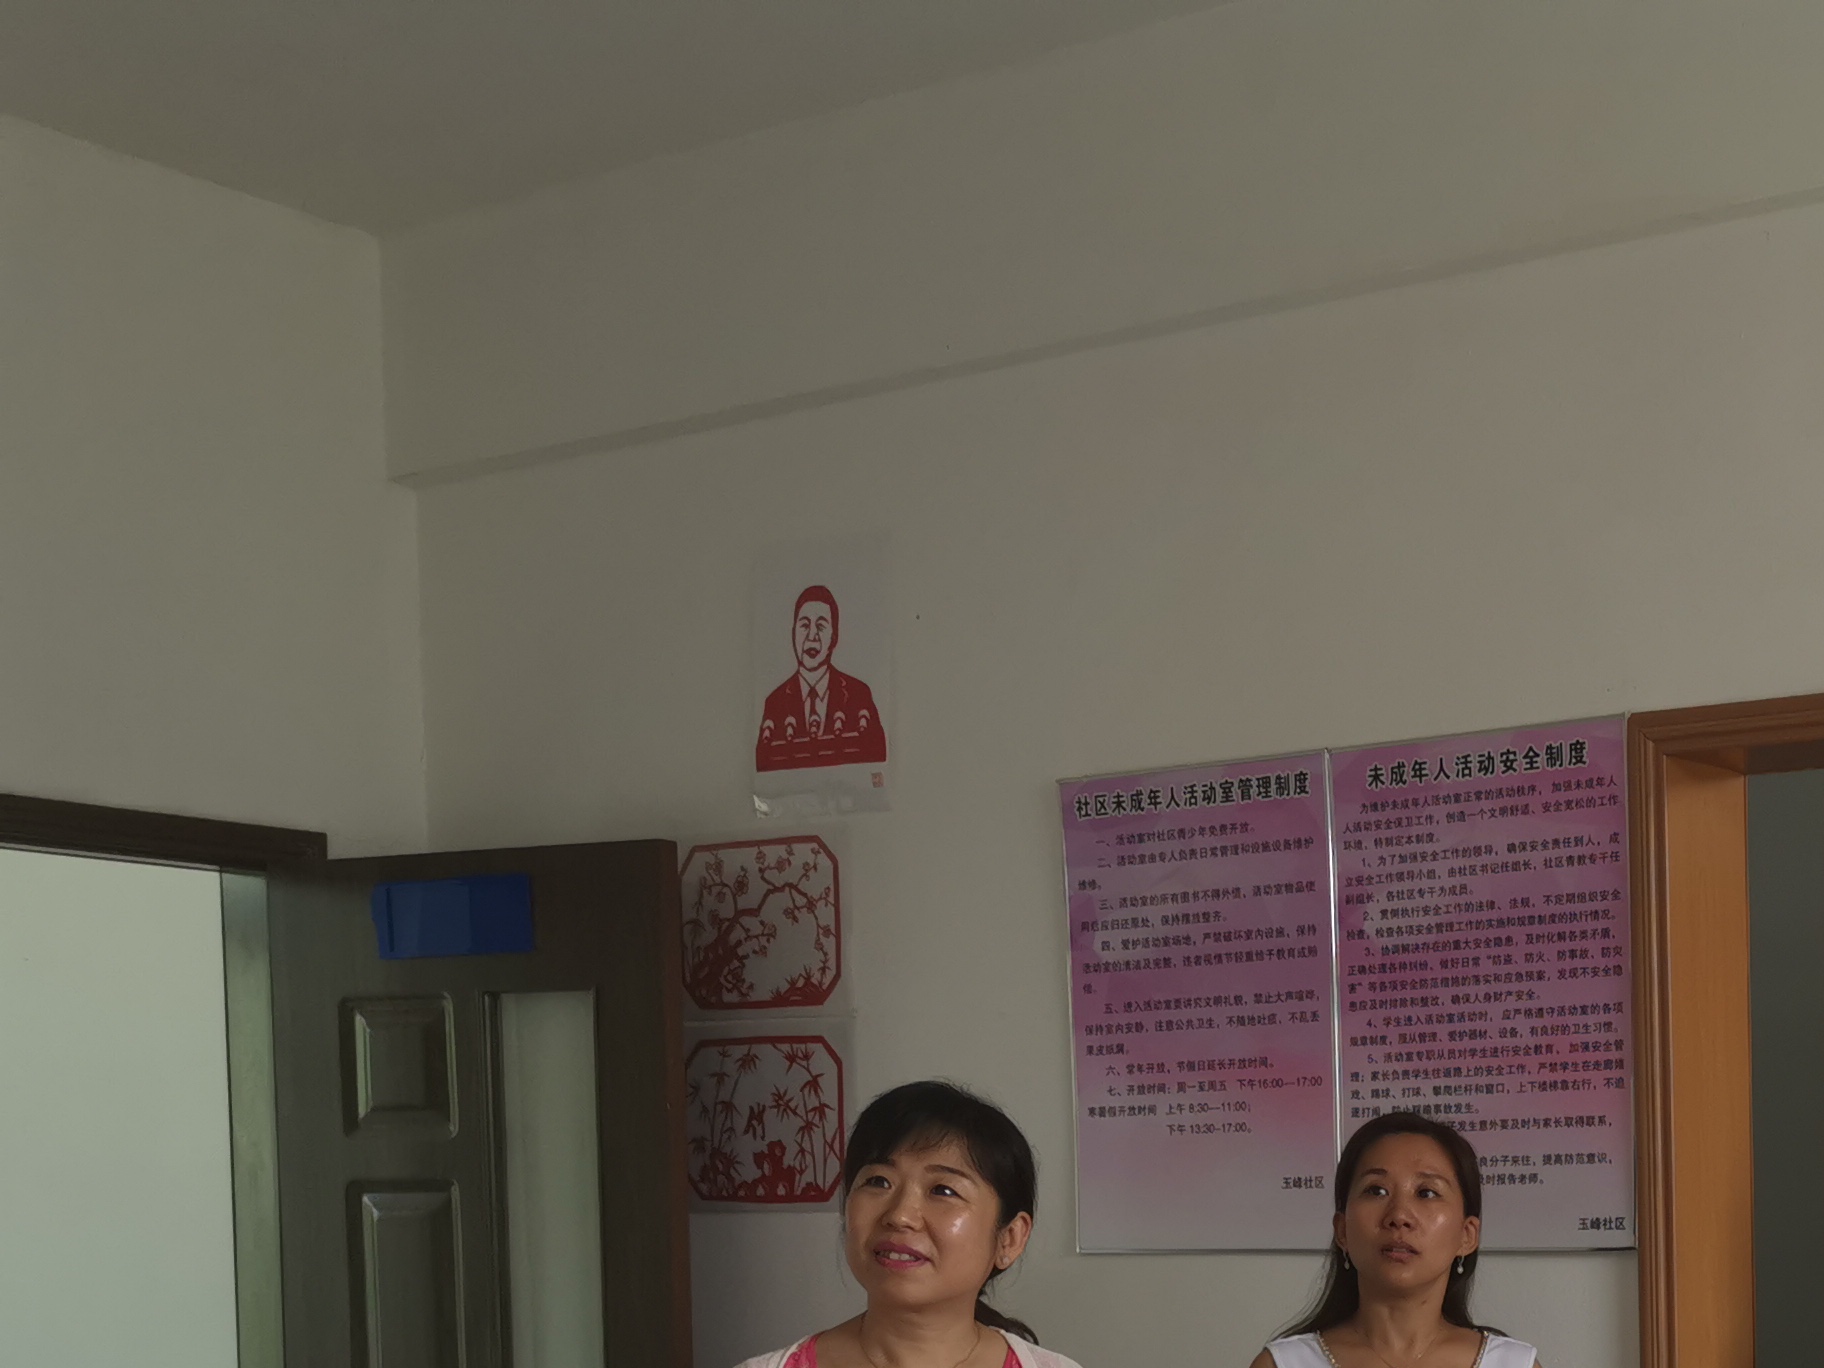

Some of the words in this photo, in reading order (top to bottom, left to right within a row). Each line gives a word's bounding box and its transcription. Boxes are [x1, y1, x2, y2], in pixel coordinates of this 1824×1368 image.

[1367, 739, 1588, 789] 未成年人活动安全制度
[1075, 771, 1311, 819] 社区未成年人活动室管理制度
[1281, 1175, 1325, 1190] 玉峰社区
[1577, 1216, 1626, 1231] 玉峰社区
